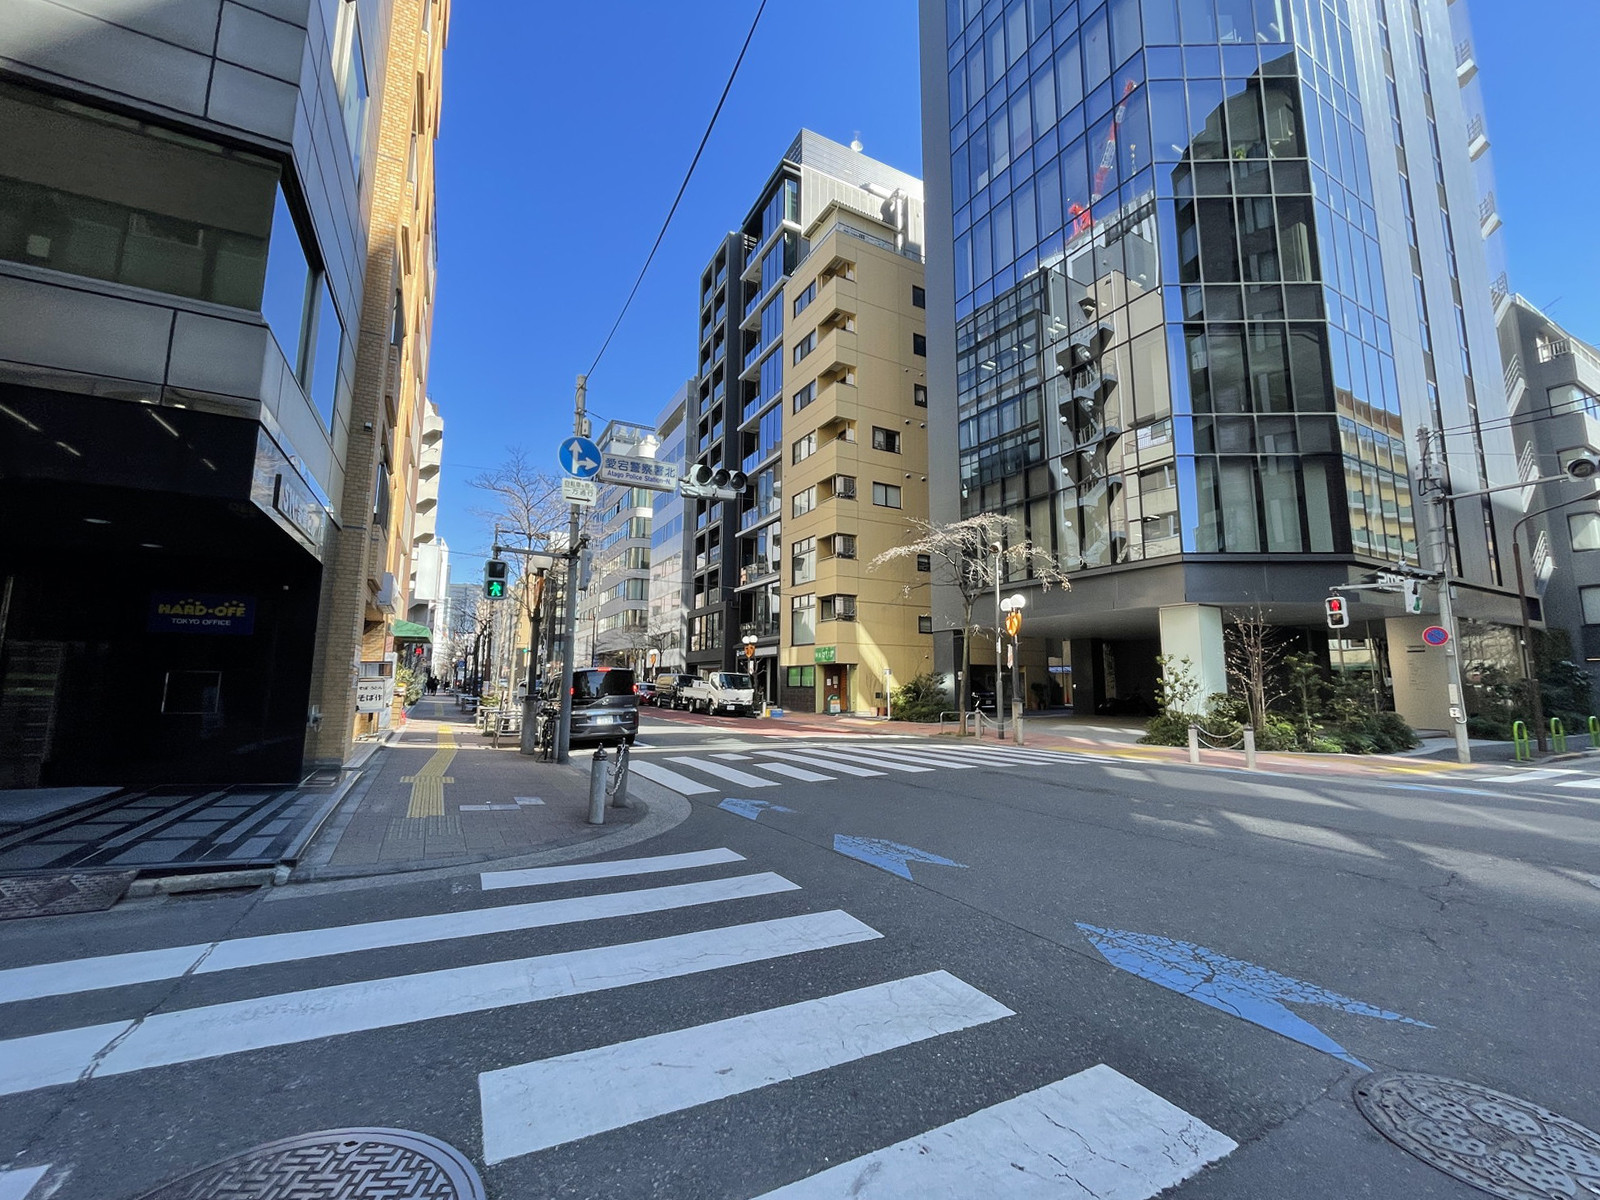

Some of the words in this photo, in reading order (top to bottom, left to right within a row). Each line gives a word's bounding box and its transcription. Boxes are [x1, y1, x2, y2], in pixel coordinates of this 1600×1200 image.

[605, 457, 676, 478] 愛宕警察署北
[607, 470, 624, 478] Atago
[625, 472, 643, 481] Police
[171, 617, 200, 625] TOKYO
[201, 618, 232, 626] OFFICE
